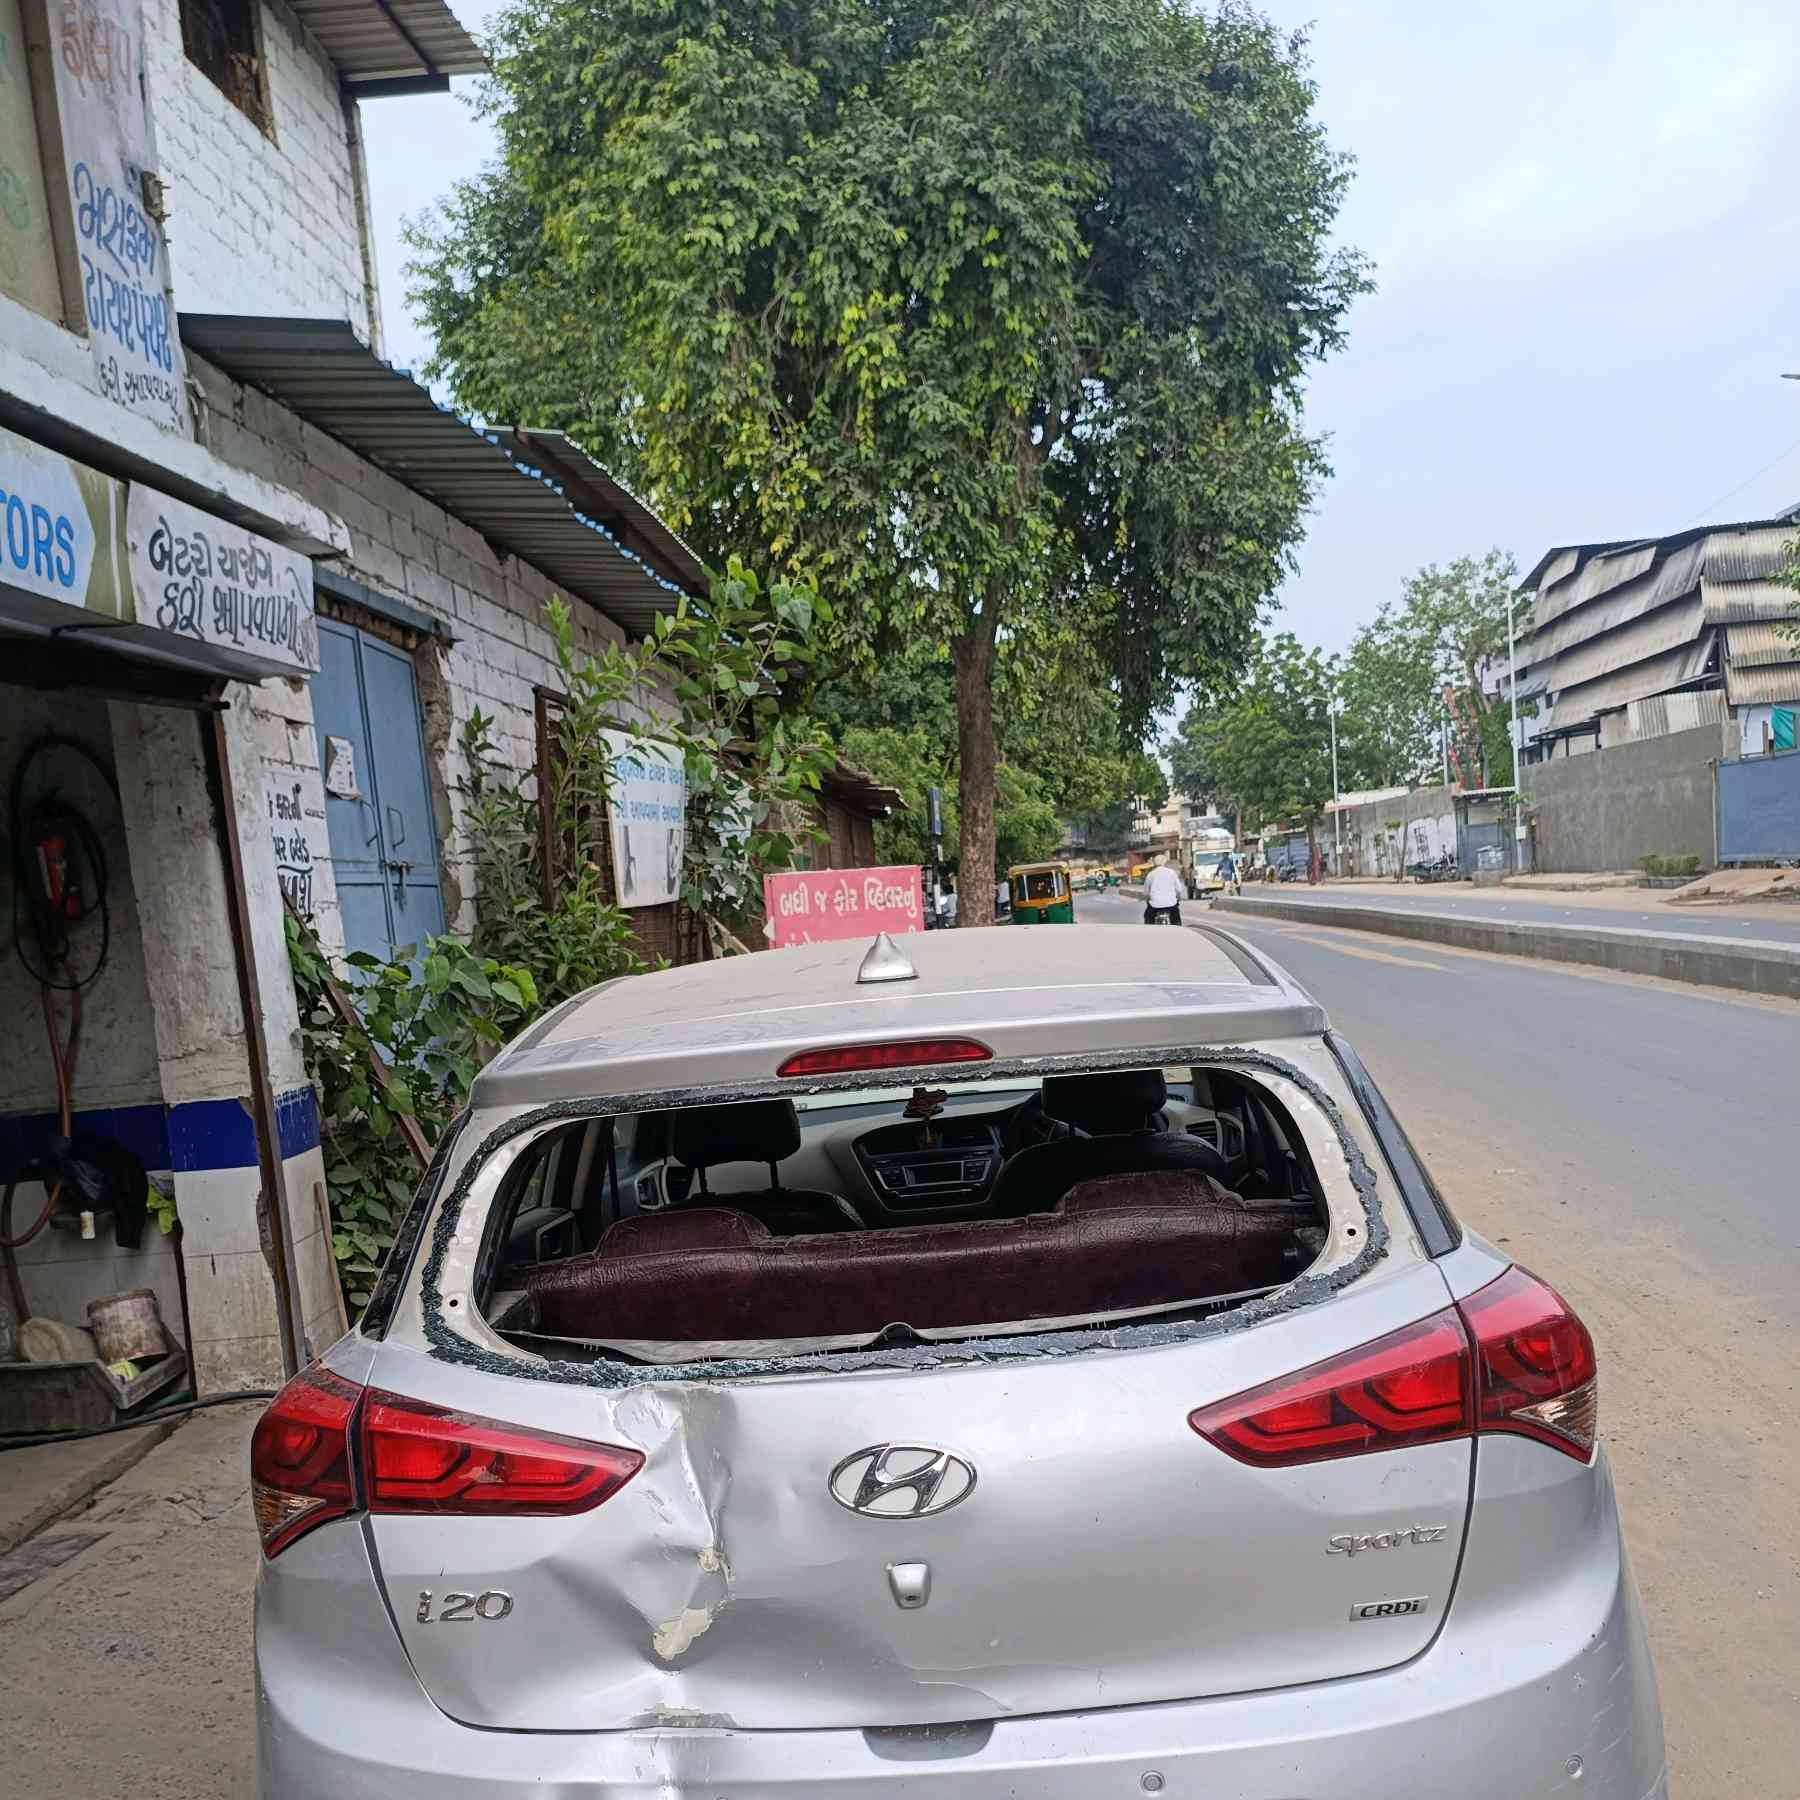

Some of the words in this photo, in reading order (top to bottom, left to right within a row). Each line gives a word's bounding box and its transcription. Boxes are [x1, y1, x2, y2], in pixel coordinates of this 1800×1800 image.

[149, 514, 212, 578] બેટરી
[157, 575, 205, 643] કરી
[815, 890, 829, 912] જ
[833, 879, 858, 917] ફોર
[1326, 1525, 1448, 1558] Sportz
[417, 1589, 514, 1624] i20
